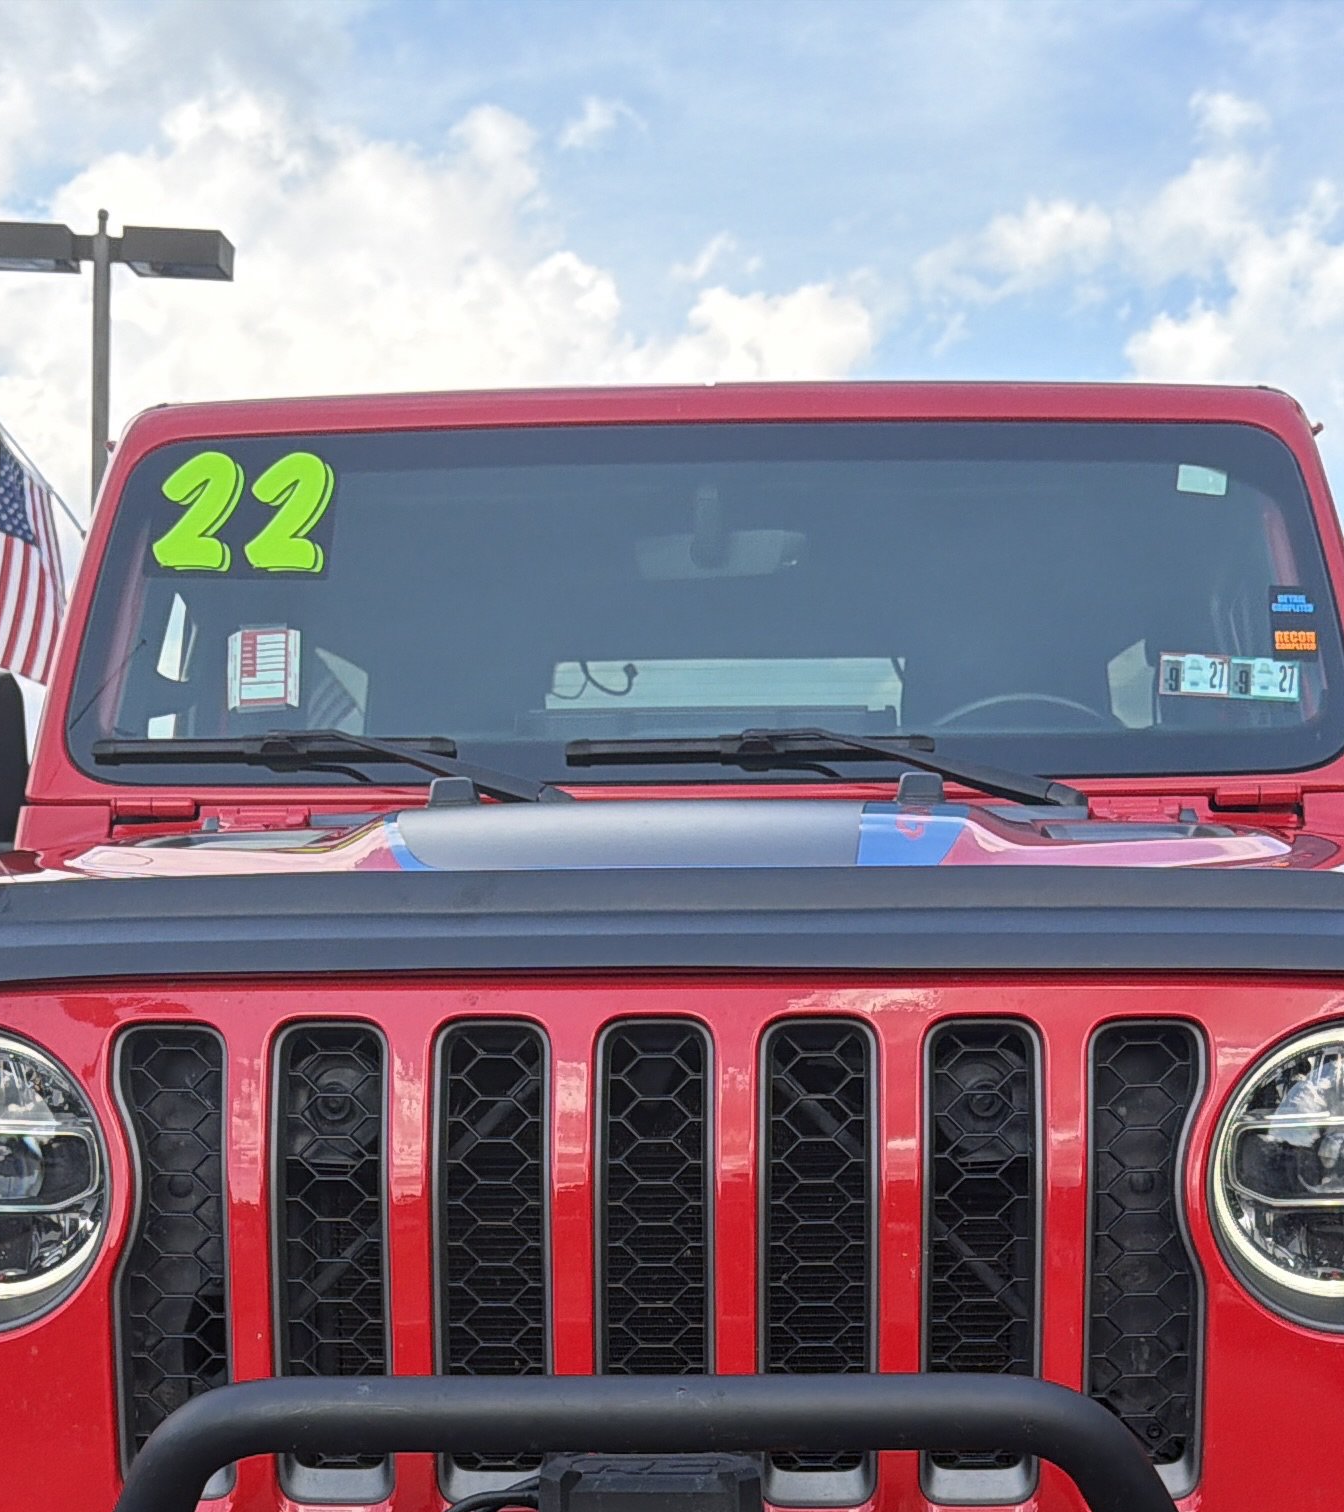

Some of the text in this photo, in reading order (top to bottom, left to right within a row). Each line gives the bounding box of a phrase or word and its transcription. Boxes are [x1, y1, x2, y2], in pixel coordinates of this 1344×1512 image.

[152, 451, 335, 573] 22
[1274, 631, 1316, 643] RECON
[1209, 660, 1225, 690] 27
[1278, 664, 1295, 694] 27
